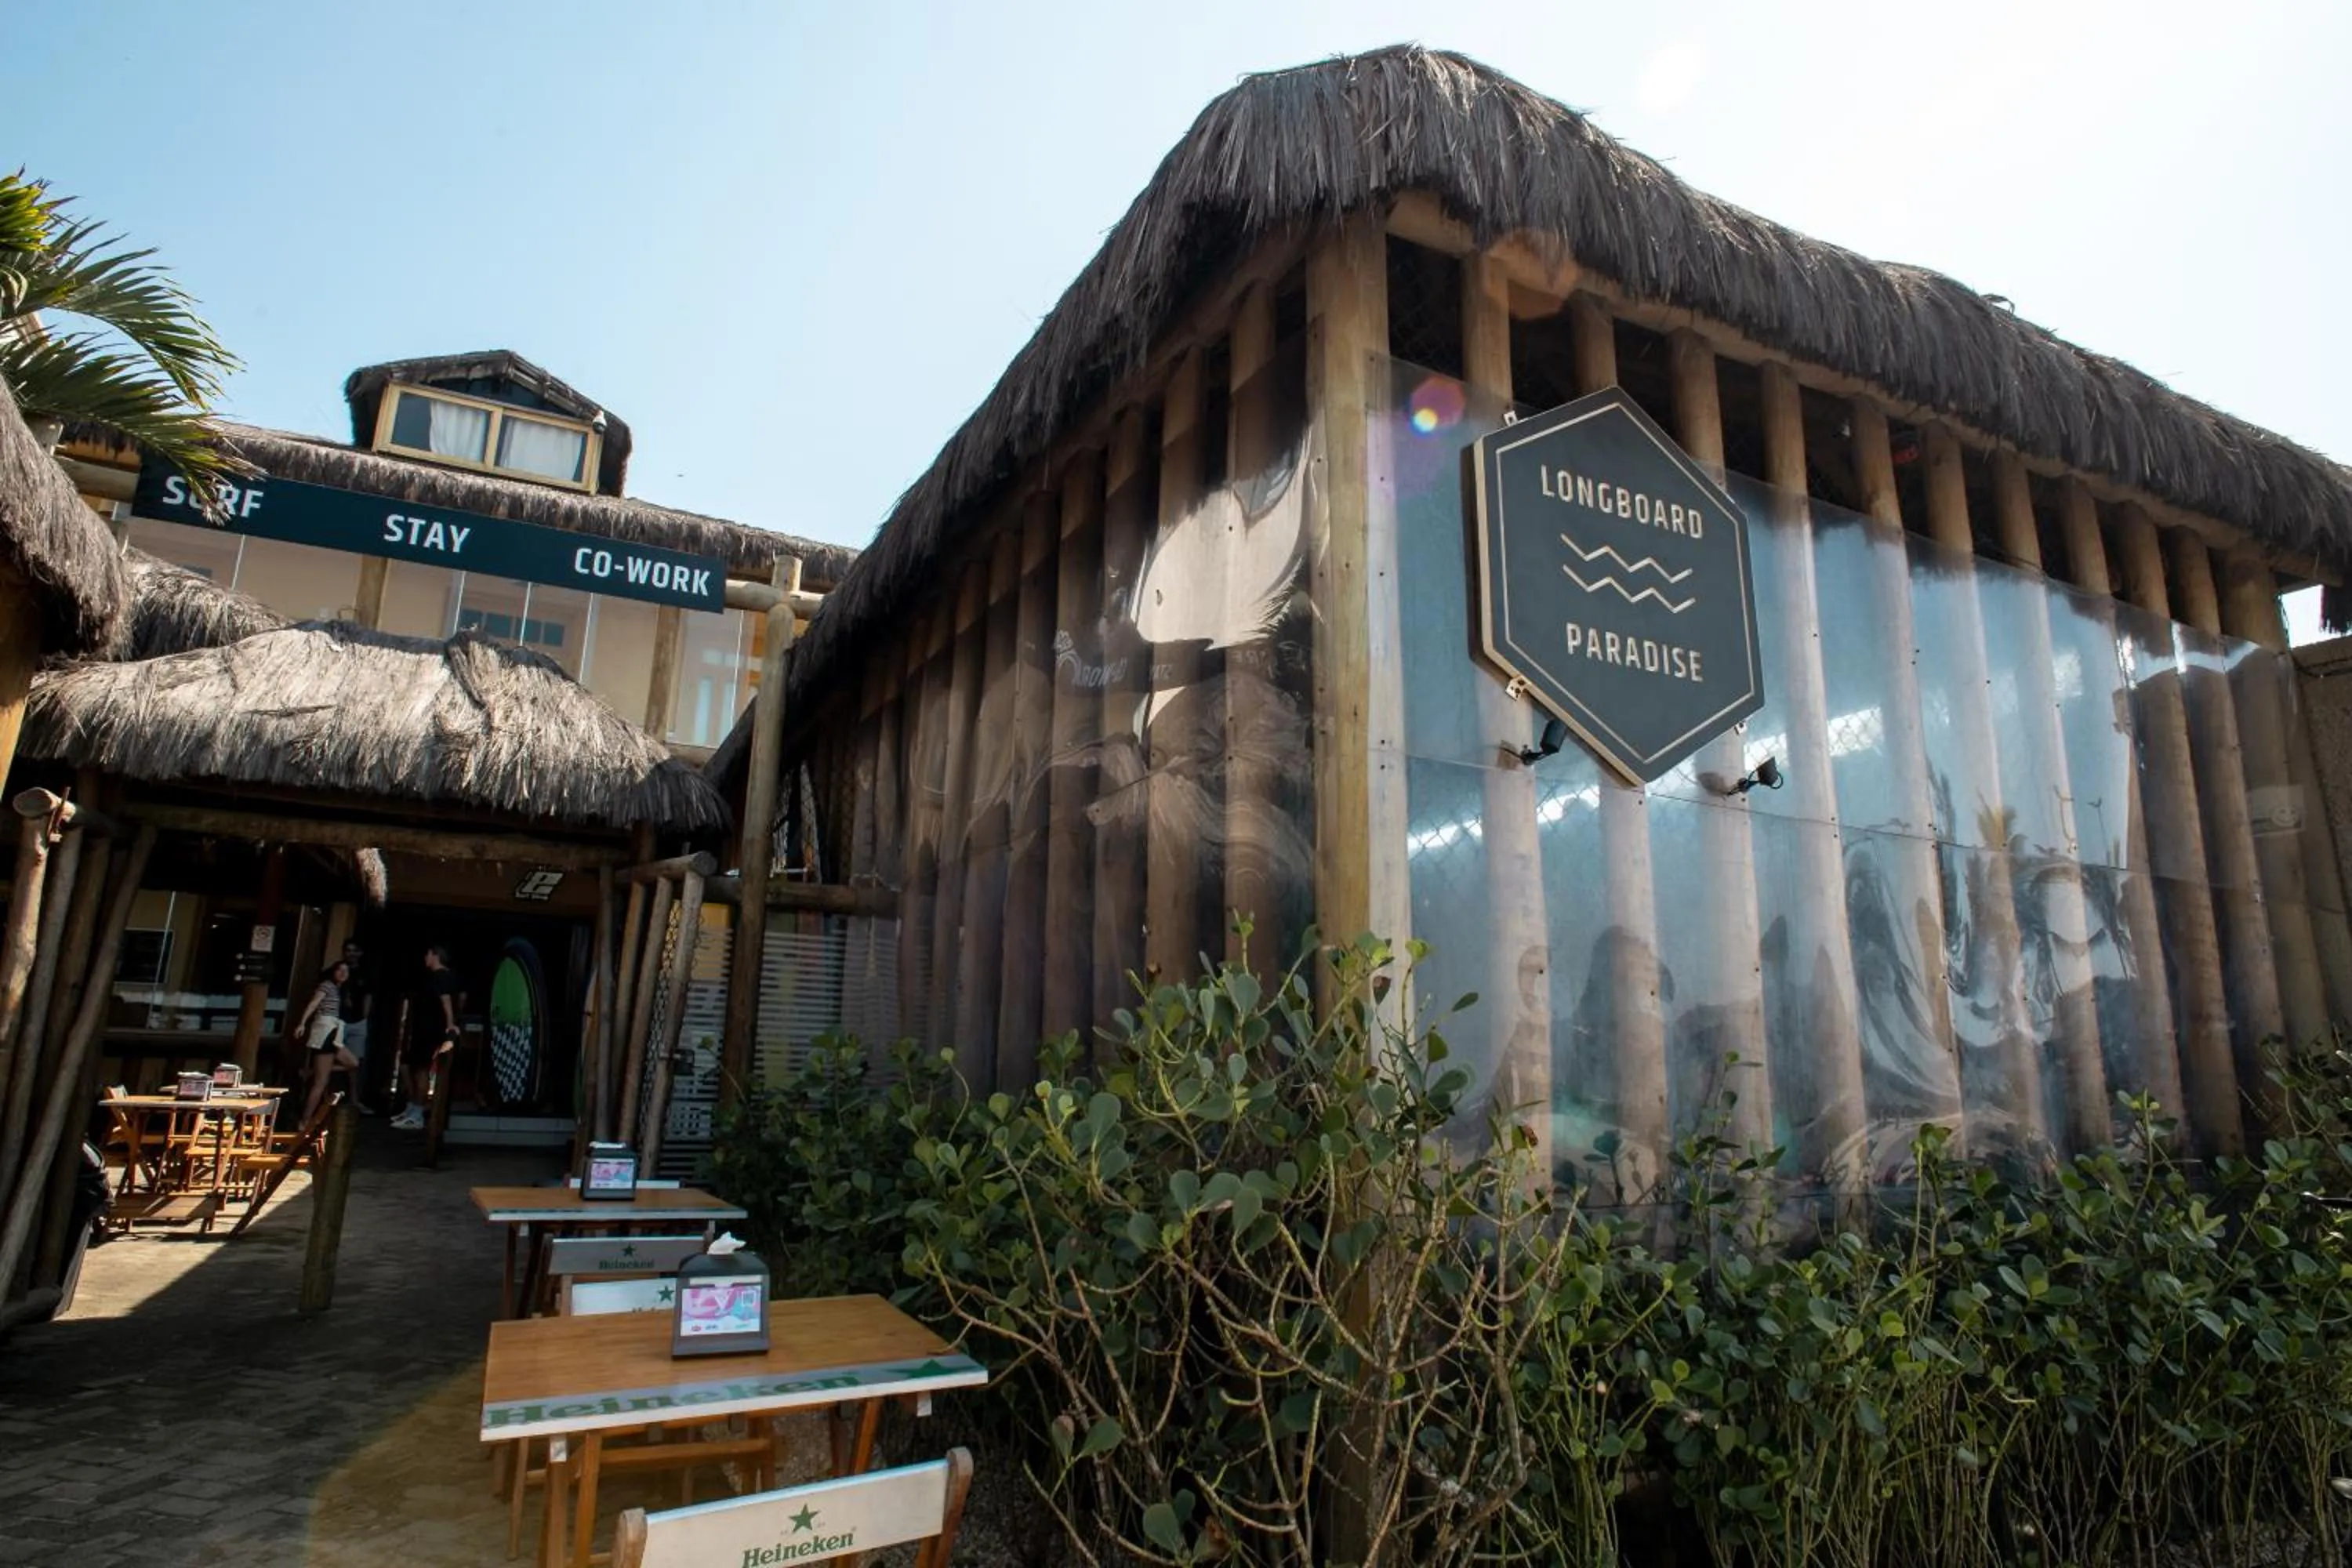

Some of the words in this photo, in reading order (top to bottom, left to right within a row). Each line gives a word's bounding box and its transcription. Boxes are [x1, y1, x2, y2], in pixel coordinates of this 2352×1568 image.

[1541, 464, 1703, 539] LONGBOARD
[383, 514, 471, 553] STAY
[575, 547, 711, 596] CO-WORK
[1566, 622, 1703, 682] PARADISE
[485, 1374, 861, 1428] Heineken
[742, 1533, 855, 1568] Heineken
